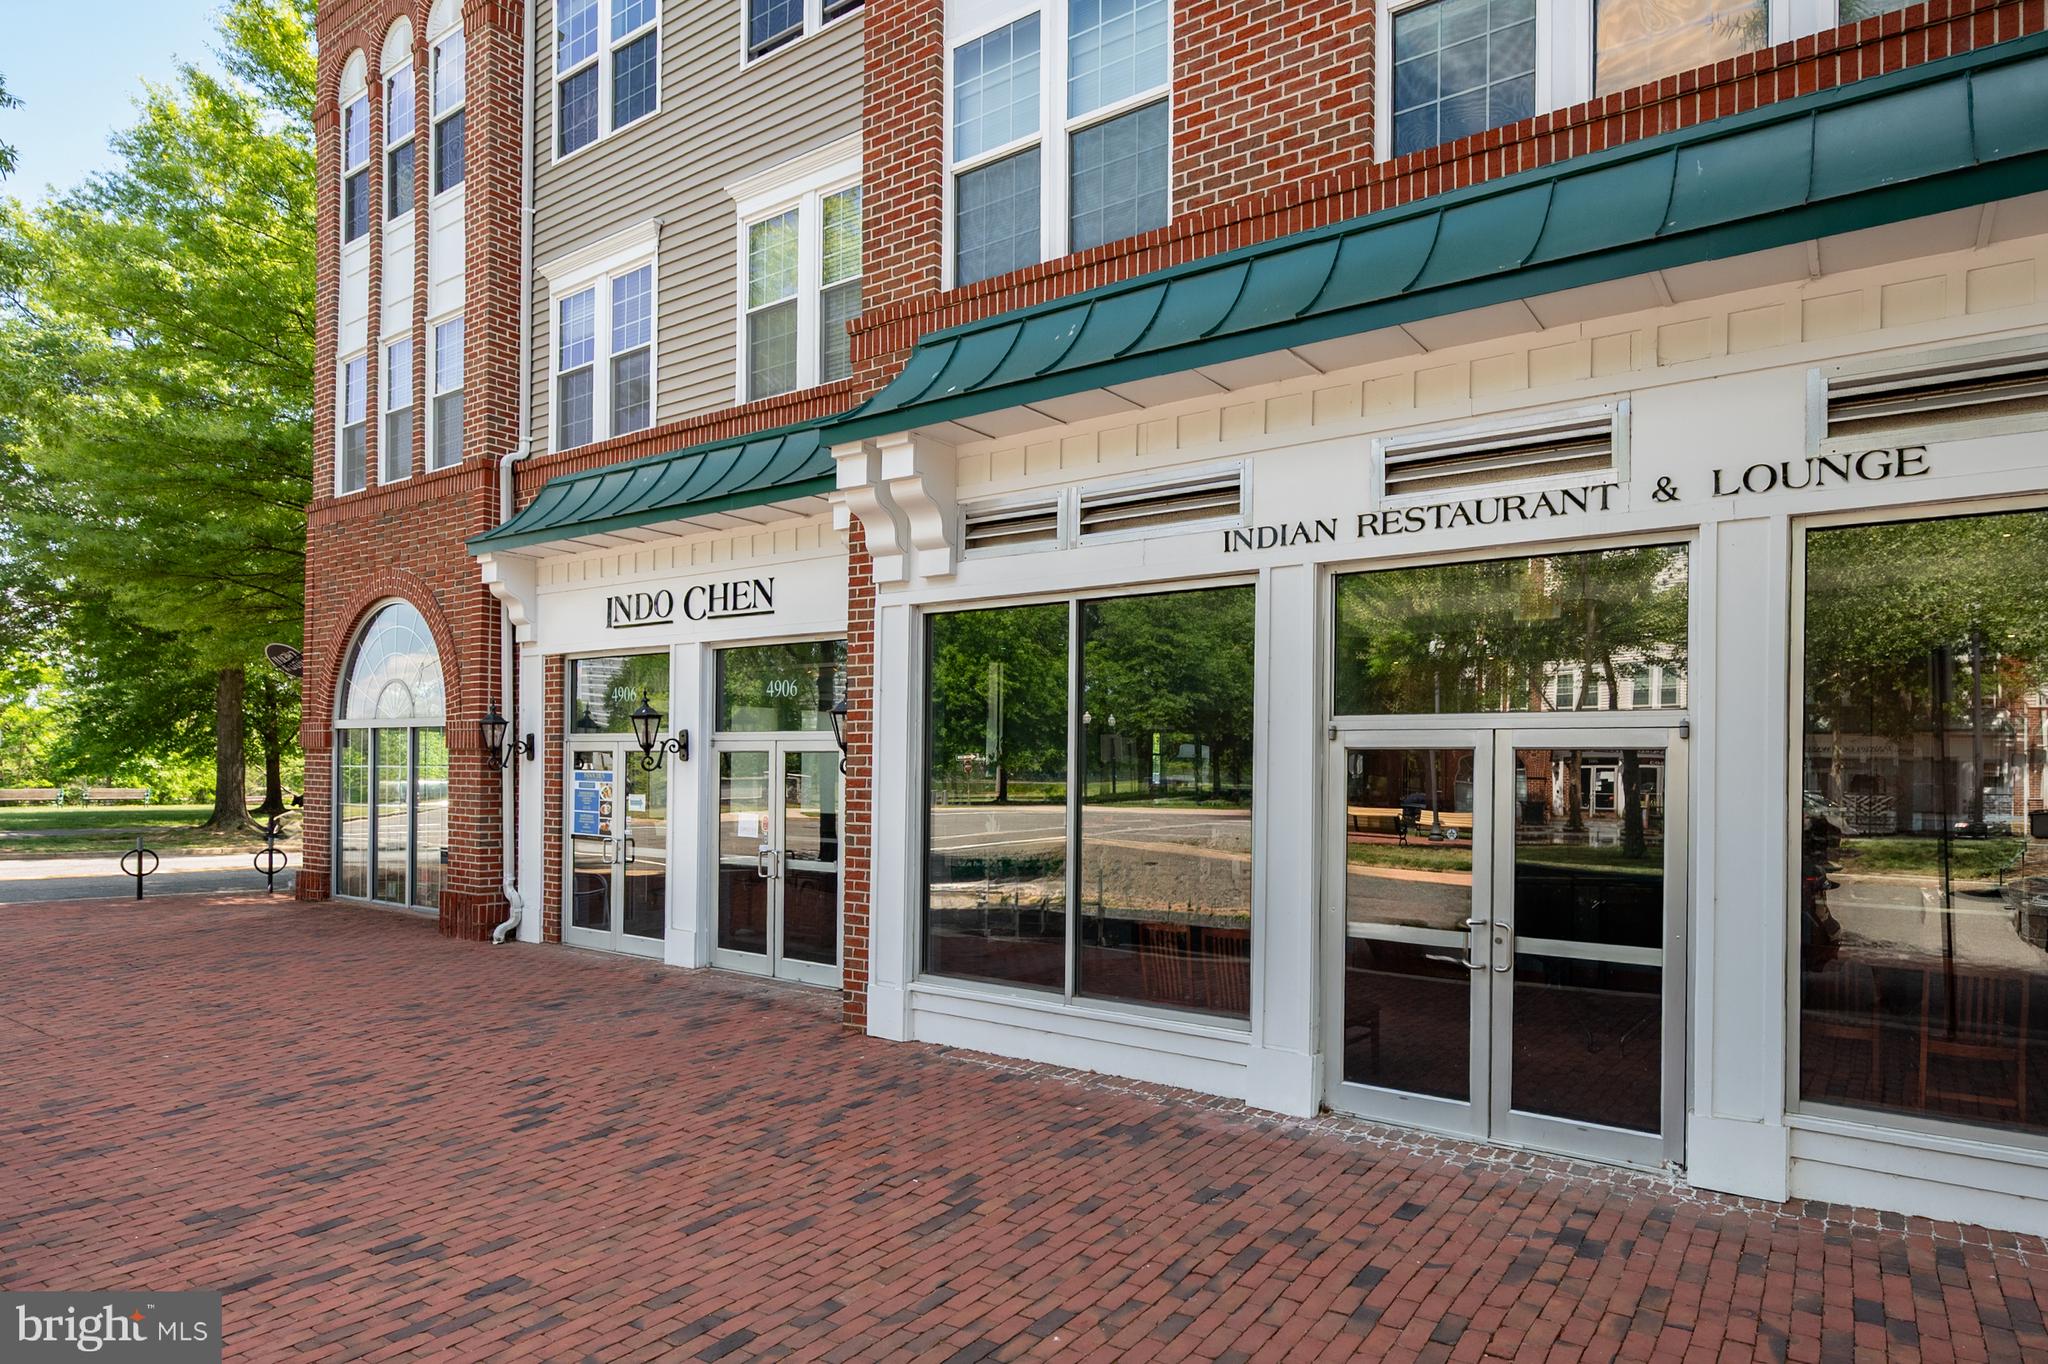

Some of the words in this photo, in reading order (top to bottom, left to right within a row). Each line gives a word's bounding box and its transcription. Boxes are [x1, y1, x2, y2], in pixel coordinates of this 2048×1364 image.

[1223, 518, 1338, 553] INDIAN
[1356, 482, 1620, 539] RESTAURANT
[1651, 475, 1681, 503] &
[1711, 445, 1931, 498] LOUNGE
[605, 588, 674, 629] INDO
[683, 576, 776, 622] CHEN
[611, 686, 637, 702] 4906
[765, 679, 798, 698] 4906
